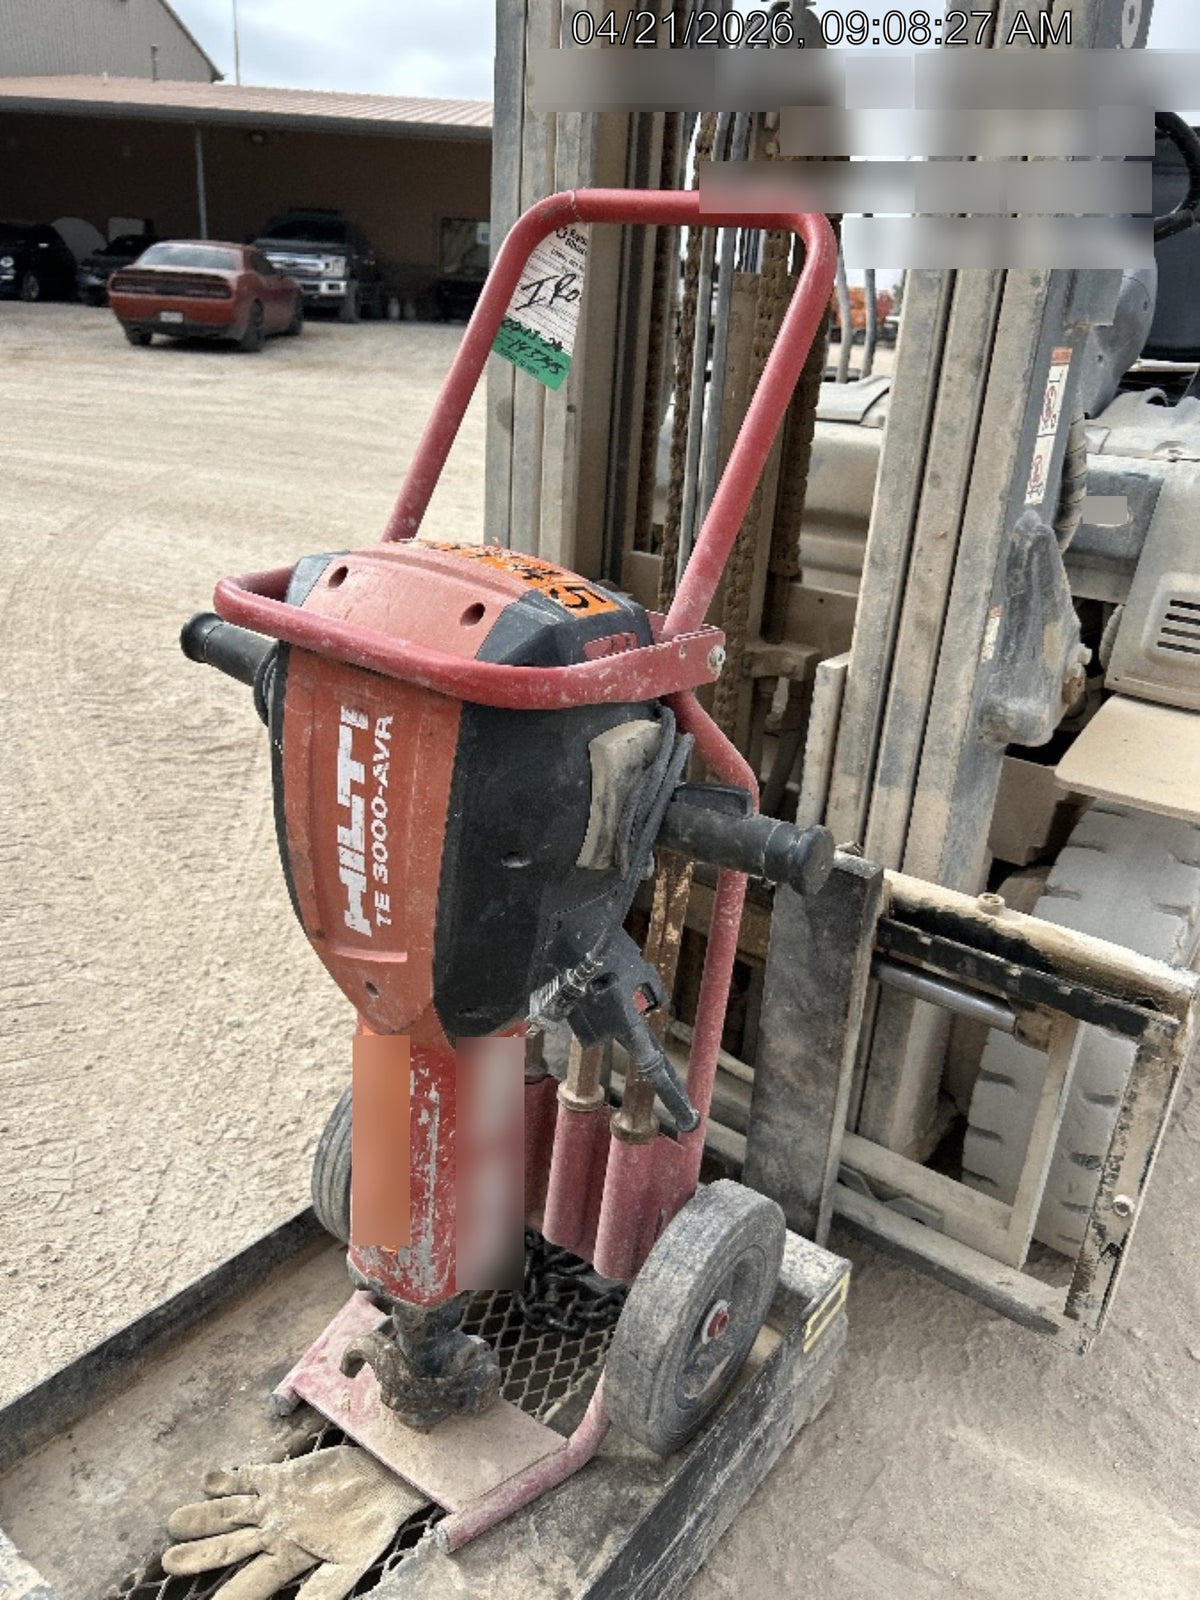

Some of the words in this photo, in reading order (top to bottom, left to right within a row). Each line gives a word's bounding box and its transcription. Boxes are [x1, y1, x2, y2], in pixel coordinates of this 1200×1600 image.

[336, 704, 372, 938] HILTI
[371, 713, 394, 885] 3000-AVR
[374, 889, 392, 927] TE
